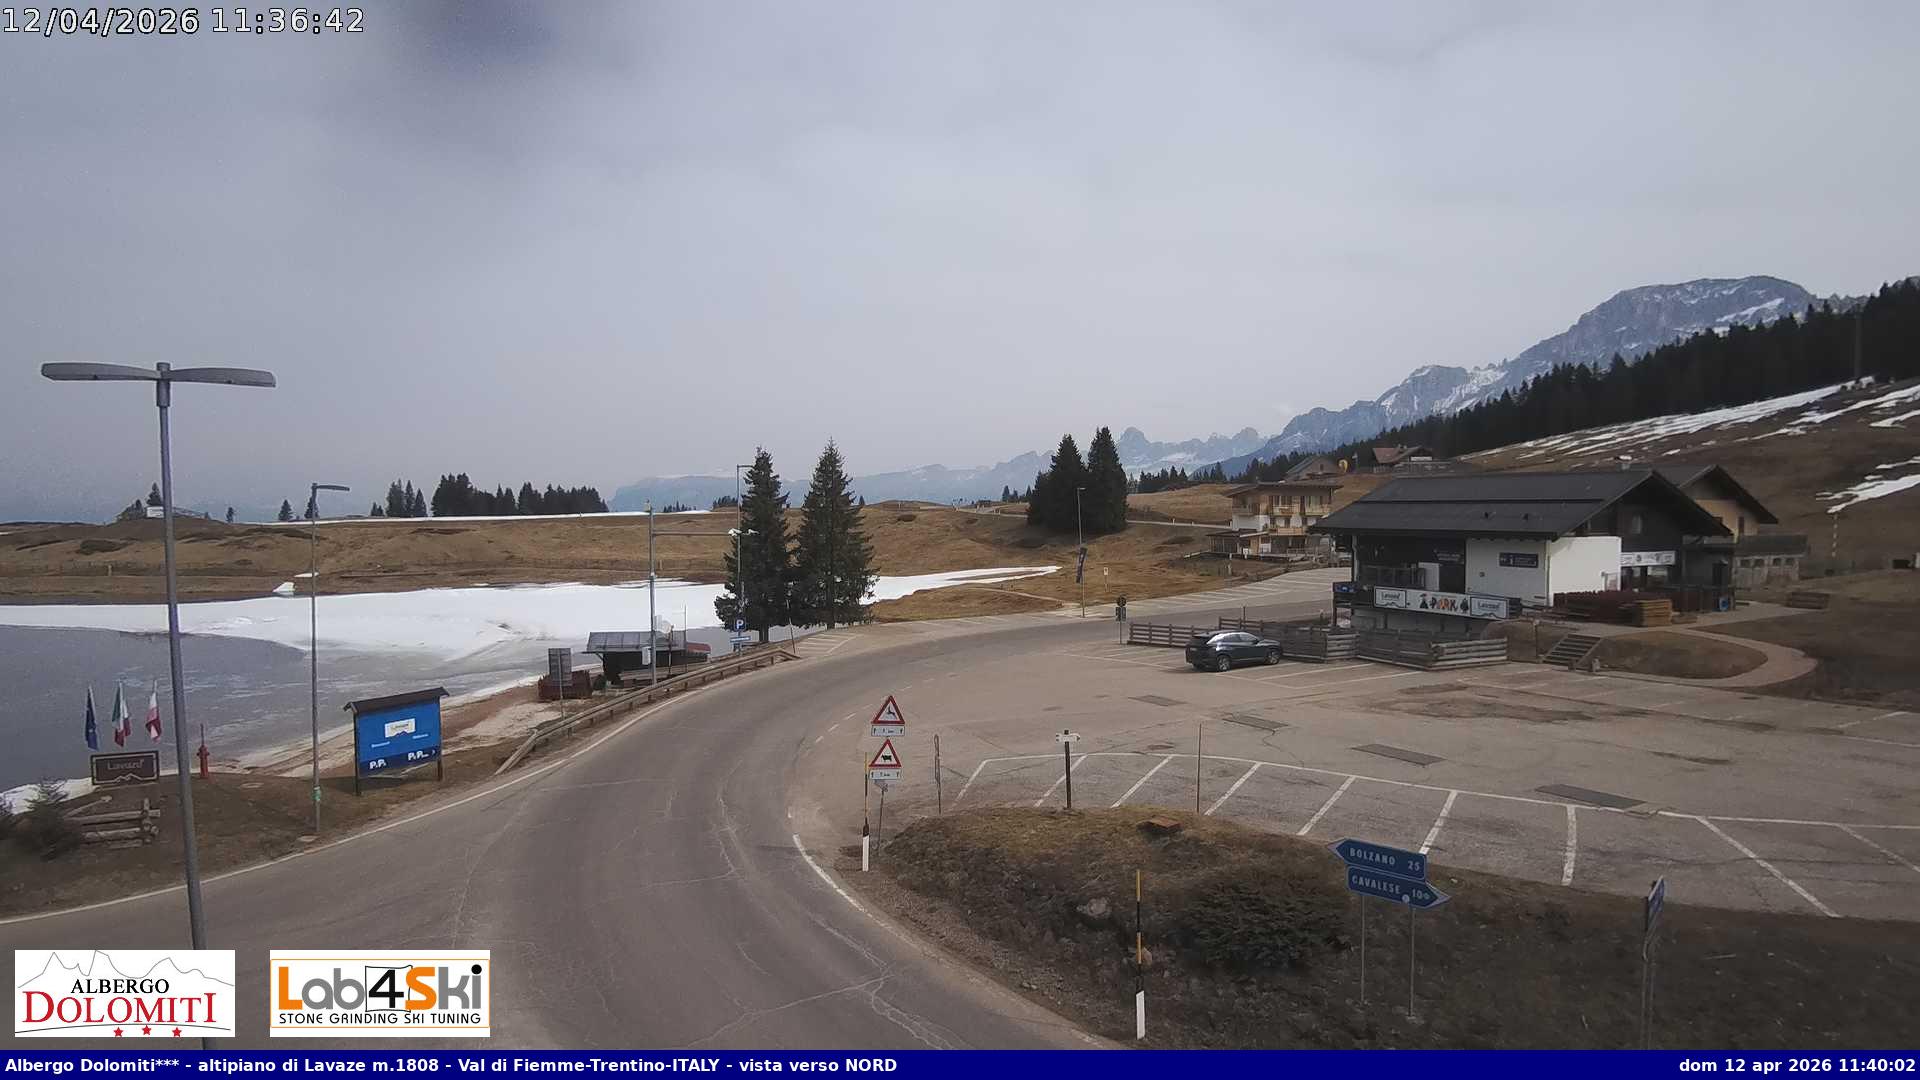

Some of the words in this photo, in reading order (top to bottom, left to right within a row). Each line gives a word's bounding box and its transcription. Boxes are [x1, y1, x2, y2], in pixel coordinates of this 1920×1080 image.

[736, 619, 744, 629] P
[1349, 847, 1396, 866] BOLZANO
[1407, 860, 1421, 872] 25
[1351, 874, 1401, 895] CAVALESE
